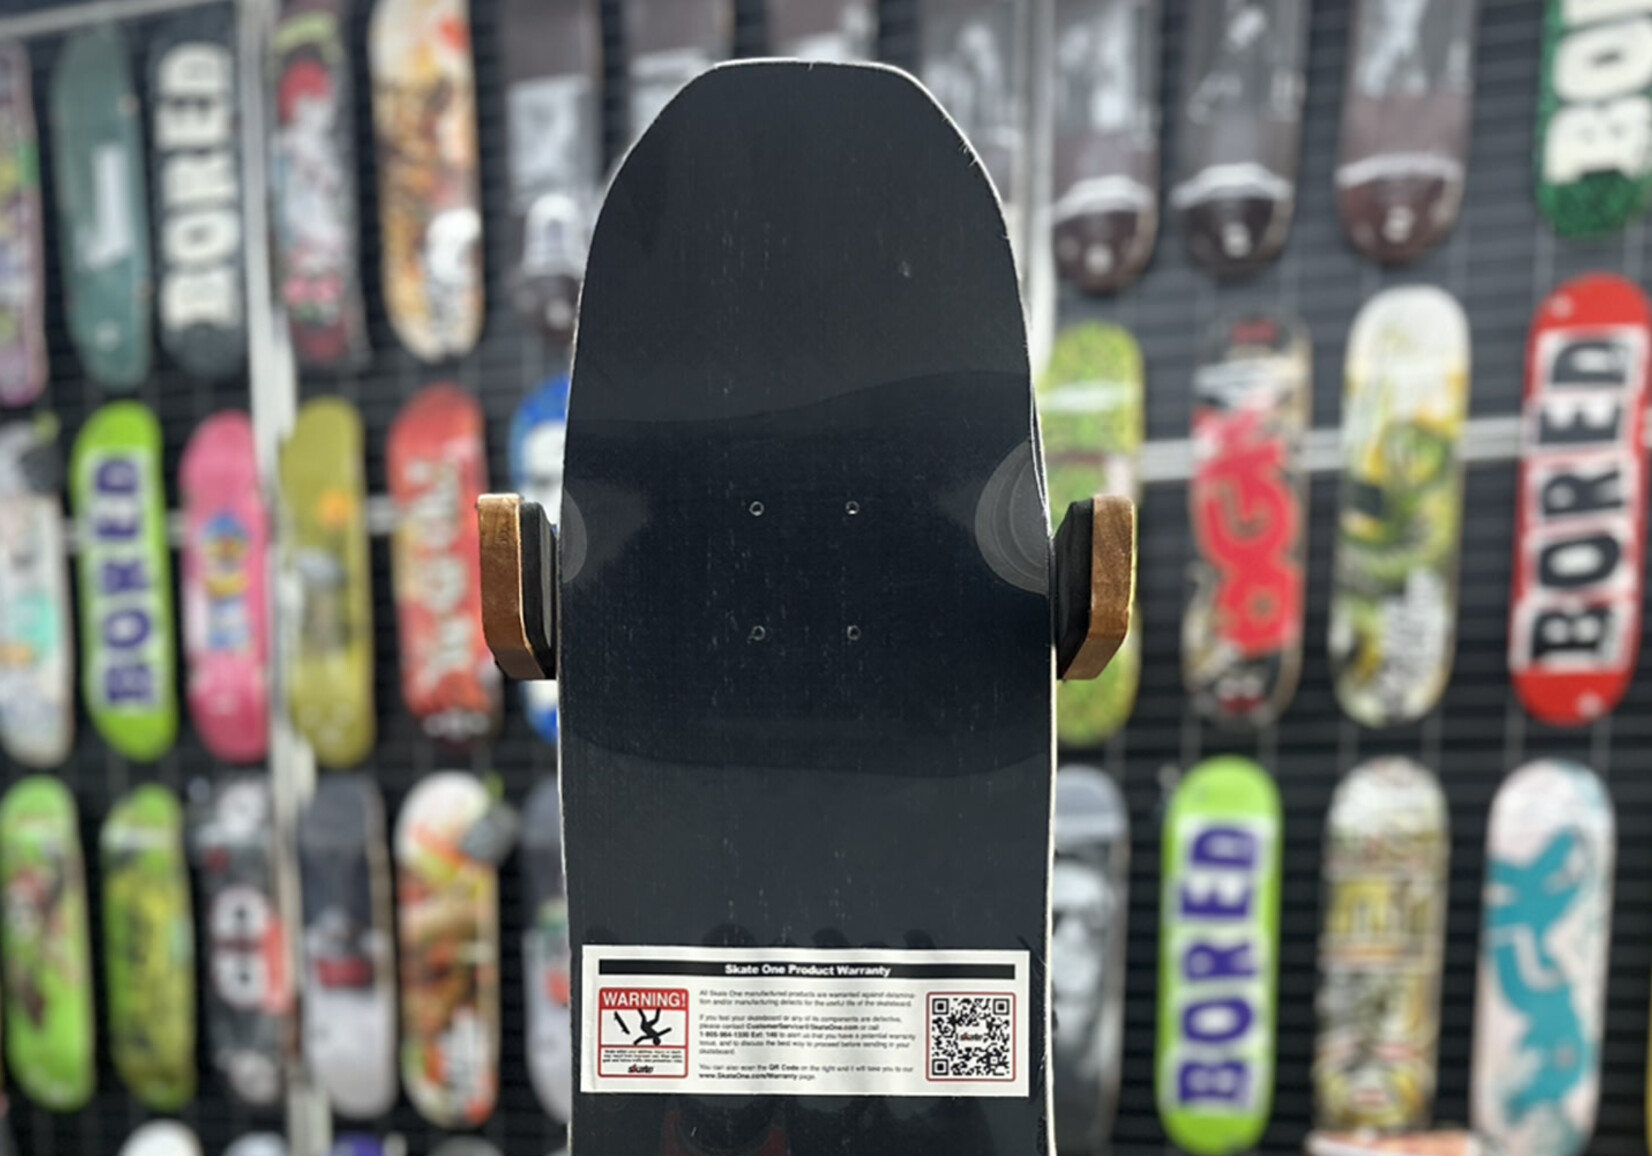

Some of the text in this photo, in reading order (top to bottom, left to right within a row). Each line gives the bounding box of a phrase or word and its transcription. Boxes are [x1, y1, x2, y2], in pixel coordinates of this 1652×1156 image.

[153, 42, 241, 327] BORED
[95, 456, 155, 704] BORED
[1534, 342, 1636, 672] BORED
[602, 992, 686, 1007] WARNING!
[725, 964, 891, 977] Skate One Product Warranty
[1177, 824, 1258, 1108] BORED
